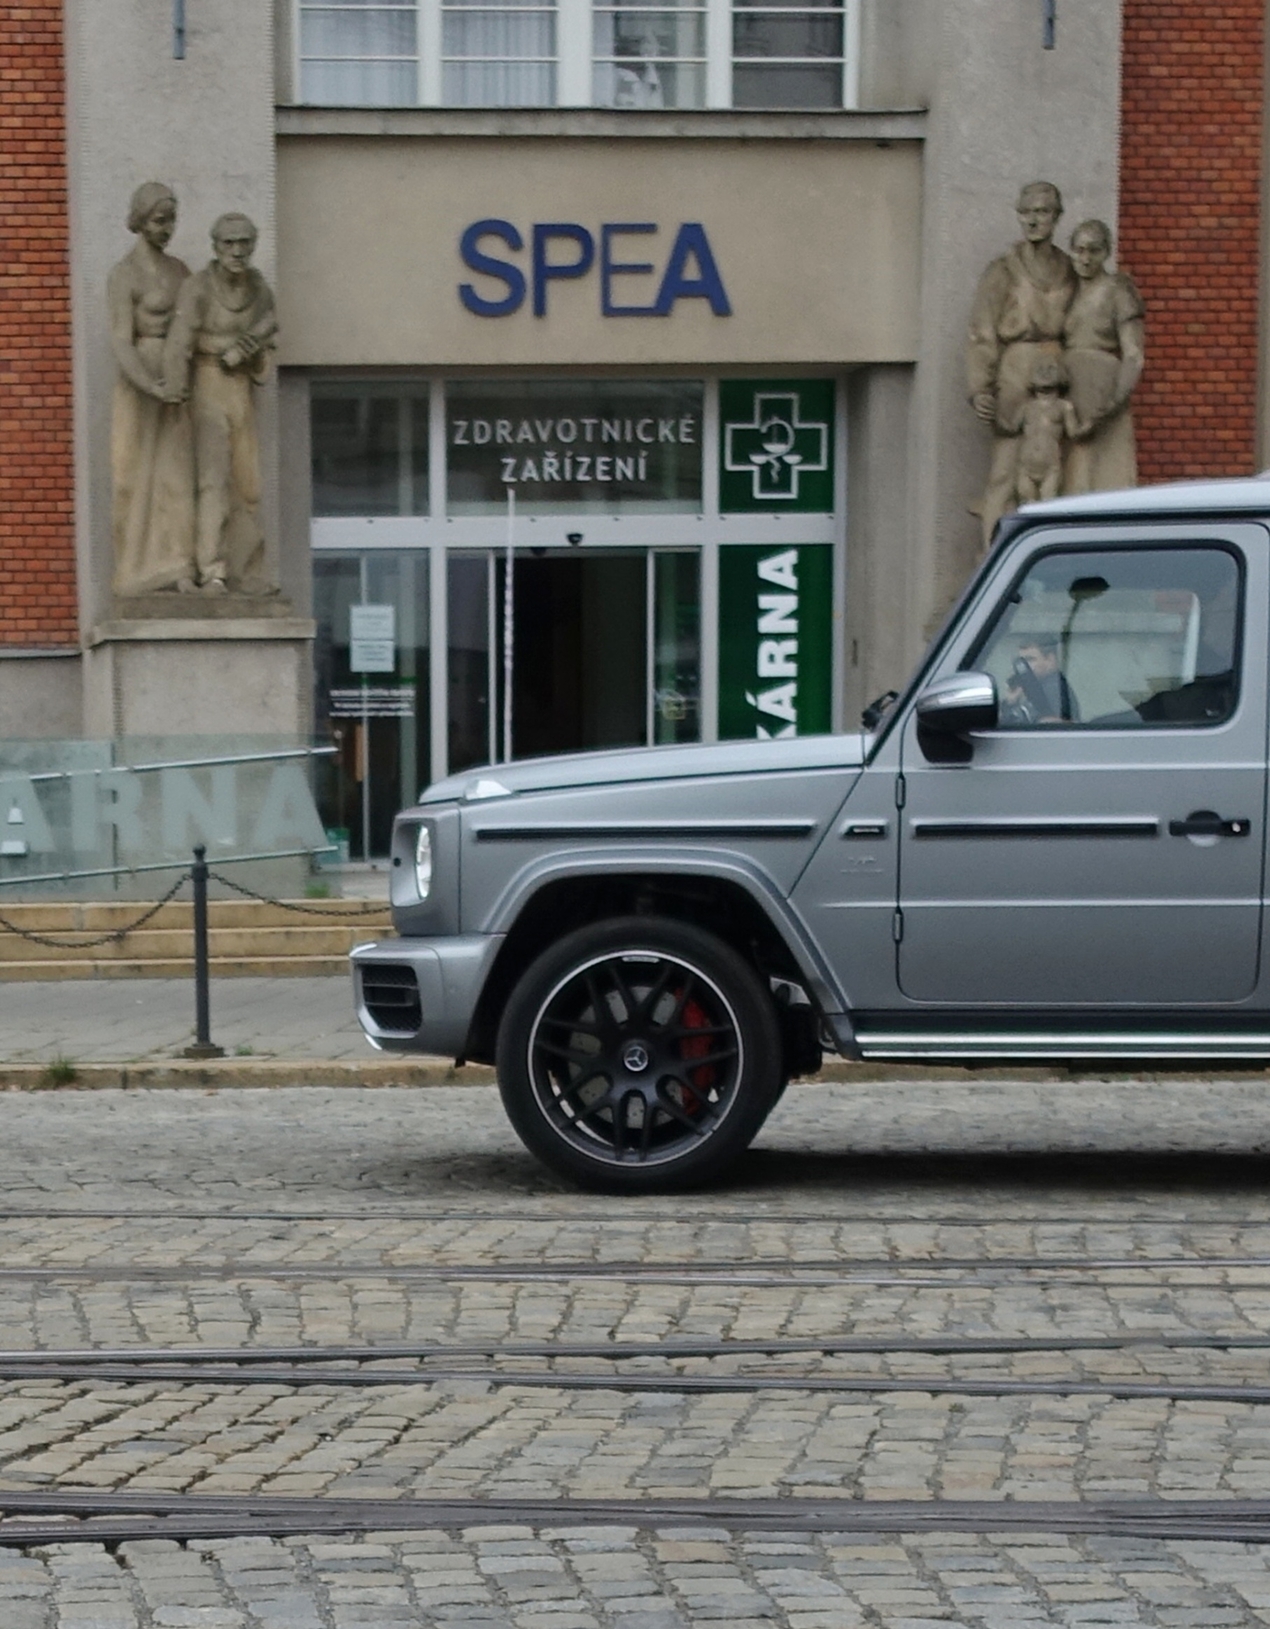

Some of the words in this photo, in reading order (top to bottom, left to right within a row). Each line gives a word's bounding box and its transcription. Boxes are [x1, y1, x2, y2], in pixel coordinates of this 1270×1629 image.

[459, 219, 732, 318] SPEA
[453, 414, 696, 445] ZDRAVOTNICKÉ
[501, 451, 649, 482] ZAŘÍZENÍ
